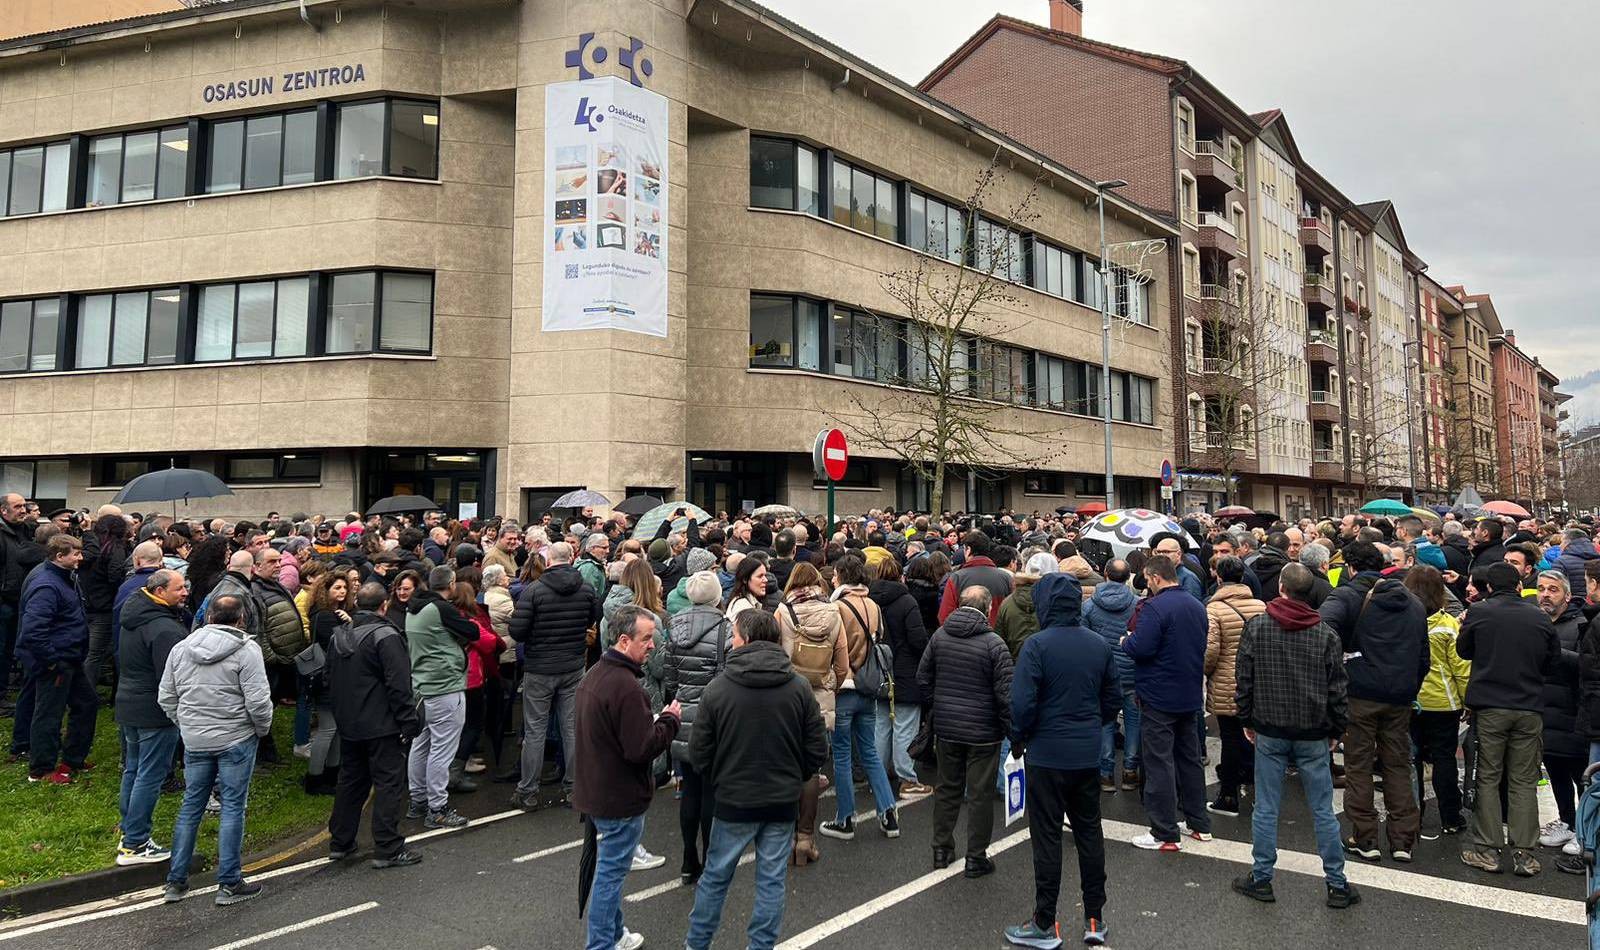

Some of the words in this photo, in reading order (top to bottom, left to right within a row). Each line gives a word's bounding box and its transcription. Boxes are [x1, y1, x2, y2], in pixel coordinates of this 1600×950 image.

[203, 77, 273, 103] OSASUN
[282, 63, 365, 92] ZENTROA
[608, 104, 646, 124] Osakidetza
